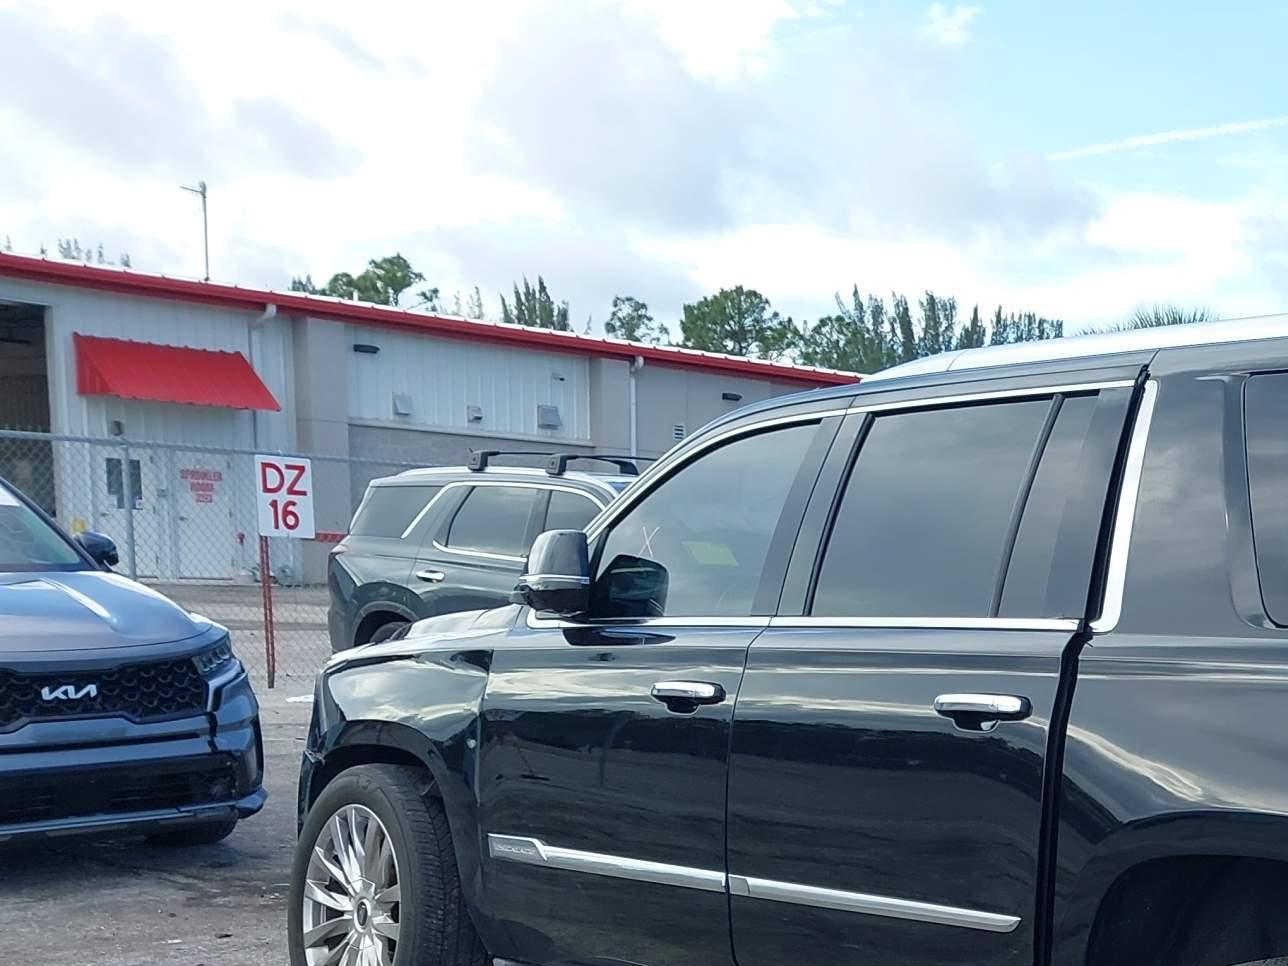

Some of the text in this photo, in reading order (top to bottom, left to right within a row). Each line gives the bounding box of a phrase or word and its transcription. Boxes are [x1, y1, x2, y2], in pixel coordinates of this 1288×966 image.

[260, 462, 307, 496] DZ
[268, 499, 300, 530] 16
[41, 684, 97, 700] KIA
